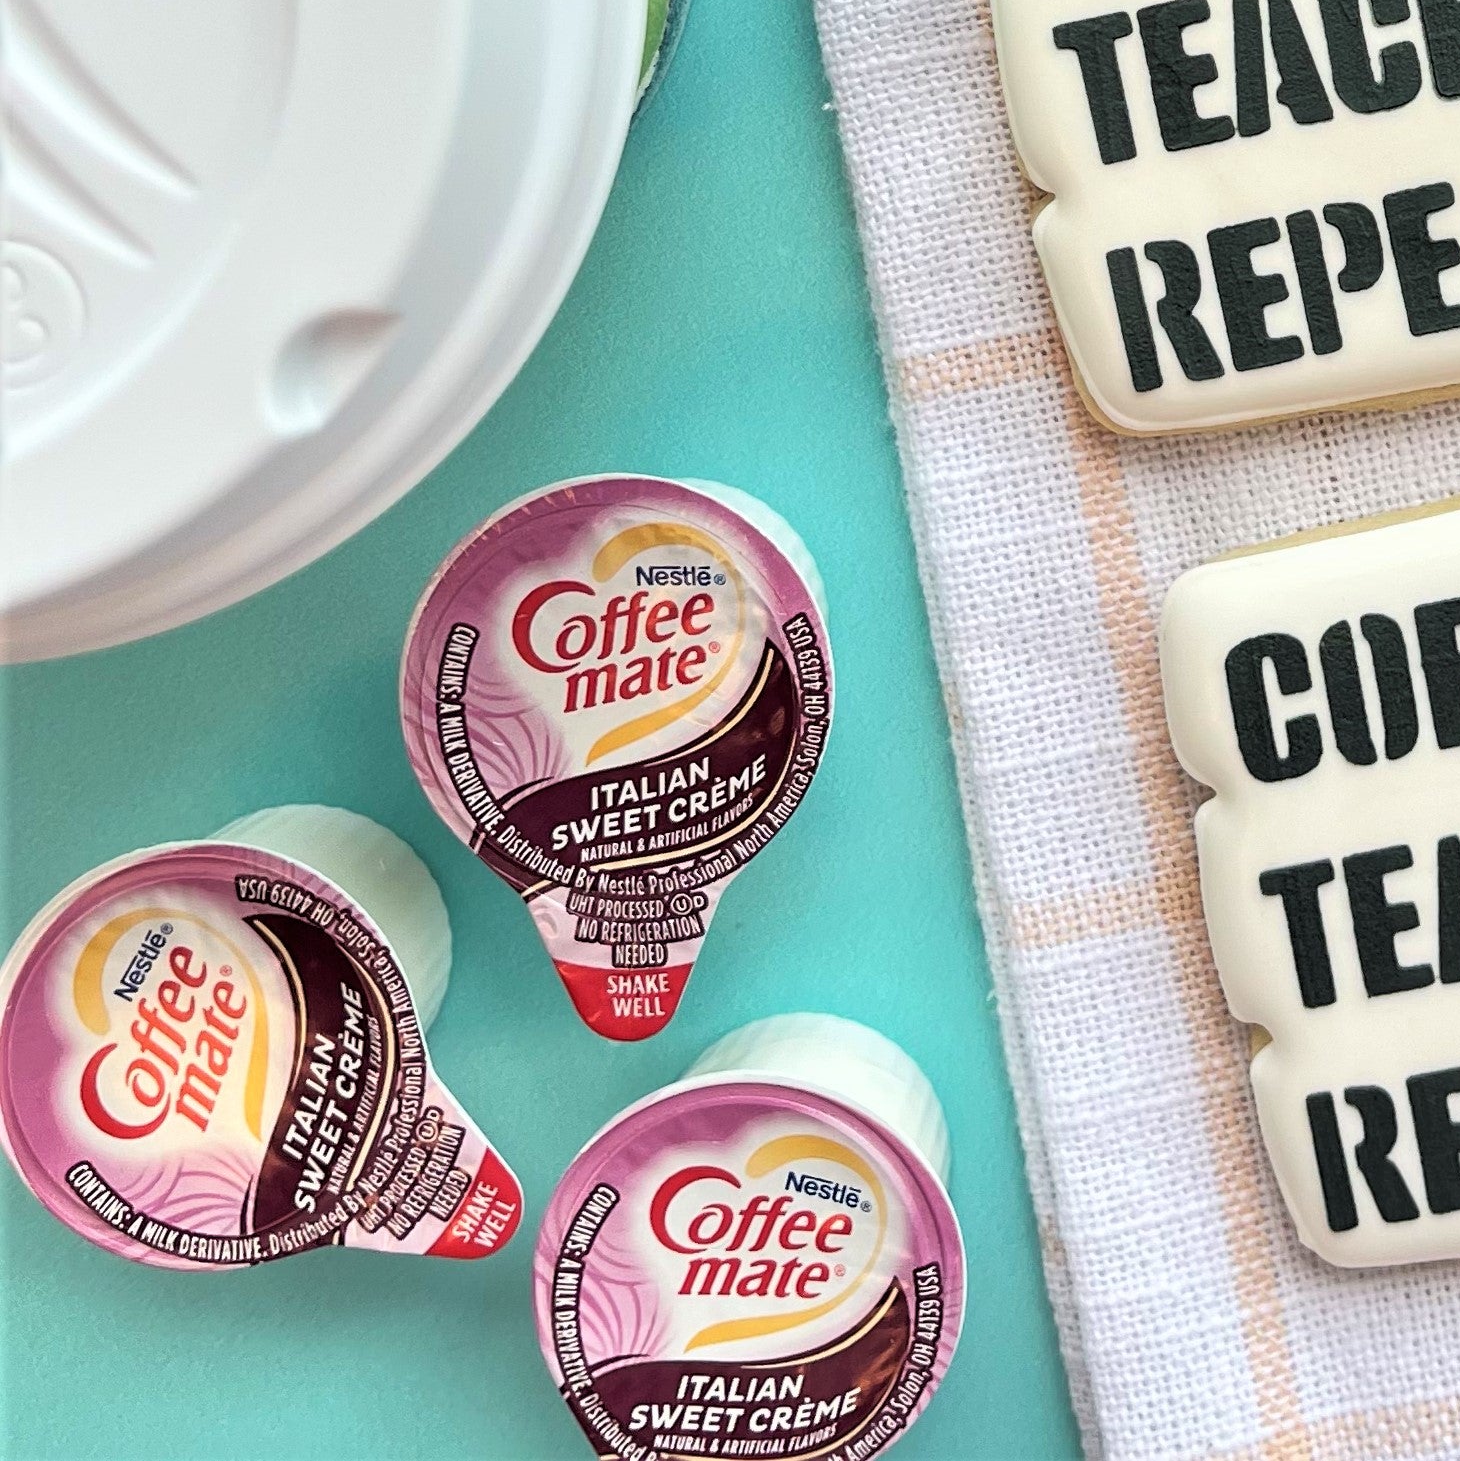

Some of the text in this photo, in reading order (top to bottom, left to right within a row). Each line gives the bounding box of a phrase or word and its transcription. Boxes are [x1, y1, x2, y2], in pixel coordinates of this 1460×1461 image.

[512, 580, 715, 674] Coffee
[563, 644, 707, 714] mate
[439, 616, 828, 896] CONTAINS: A MILK DERIVATIVE. Distributed By Nestlé Professional North America, Solon, OH 44139 USA
[551, 752, 767, 852] SWEET CRÈME
[591, 756, 710, 812] ITALIAN
[580, 792, 754, 864] NATURAL & ARTIFICIAL FLAVORS
[569, 892, 595, 914] UHT
[598, 898, 665, 919] PROCESSED
[578, 914, 702, 943] NO REFRIGERATION
[614, 943, 666, 965] NEEDED
[606, 973, 671, 995] SHAKE
[612, 996, 666, 1018] WELL
[80, 945, 207, 1140] Coffee
[175, 981, 247, 1133] mate
[366, 1013, 383, 1066] FLAVORS
[69, 877, 423, 1262] CONTAINS: A MILK DERIVATIVE. Distributed By Nestlé Professional North America, Solon, OH 44139 USA
[281, 1032, 336, 1161] ITALIAN
[352, 1067, 381, 1132] ARTIFICIAL
[294, 1098, 348, 1215] SWEET
[326, 1144, 355, 1195] NATURAL
[387, 1124, 463, 1236] NO REFRIGERATION
[359, 1203, 386, 1230] UHT
[381, 1146, 427, 1208] PROCESSED
[429, 1168, 469, 1218] NEEDED
[451, 1180, 499, 1244] SHAKE
[649, 1165, 853, 1254] Coffee
[473, 1200, 517, 1248] WELL
[677, 1256, 830, 1299] mate
[916, 1265, 940, 1297] USA
[555, 1186, 648, 1461] CONTAINS: A MILK DERIVATIVE. Distributed
[918, 1298, 941, 1340] 44139
[911, 1342, 935, 1367] OH
[628, 1386, 862, 1433] SWEET CRÈME
[676, 1374, 804, 1402] ITALIAN
[890, 1370, 931, 1414] Solon,
[653, 1422, 838, 1455] NATURAL & ARTIFICIAL FLAVORS
